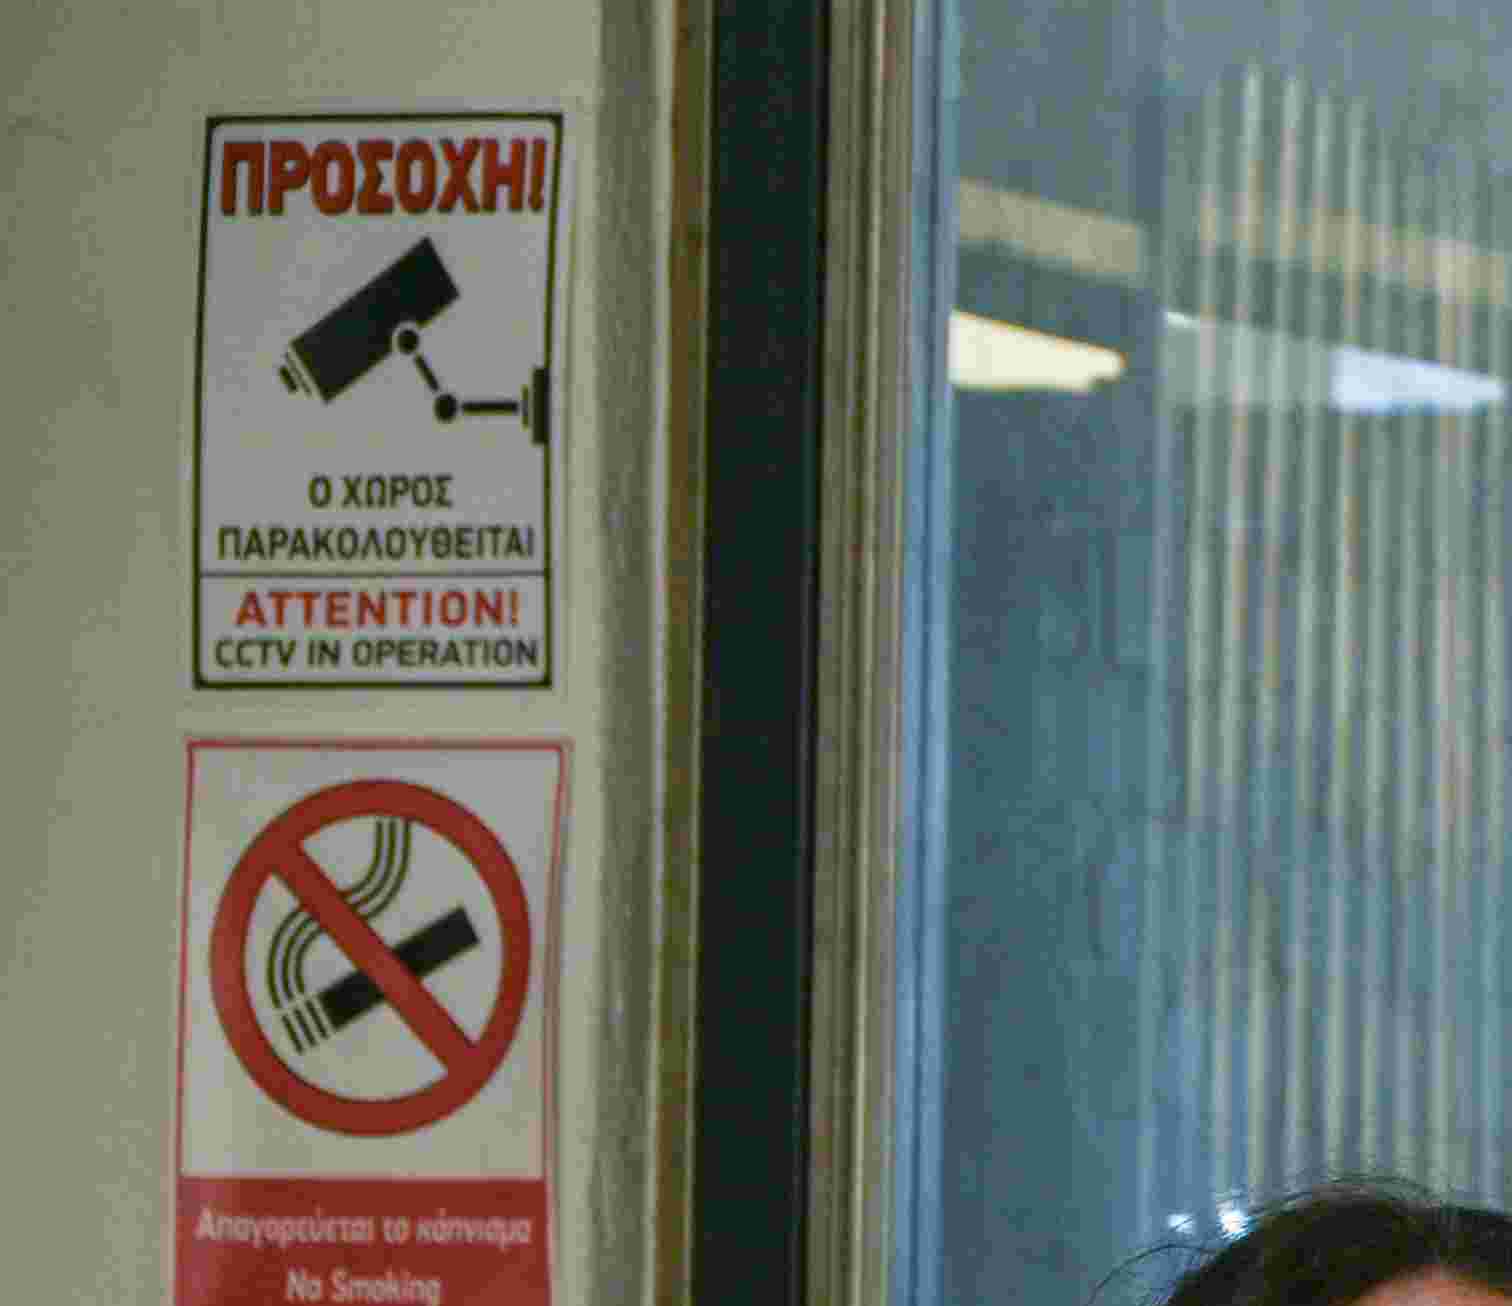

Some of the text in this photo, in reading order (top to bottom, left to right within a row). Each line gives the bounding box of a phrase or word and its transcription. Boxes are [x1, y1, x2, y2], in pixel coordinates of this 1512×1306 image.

[219, 138, 548, 216] ΠΡΟΣΟΧΗ!
[308, 474, 454, 508] Ο ΧΩΡΟΣ
[217, 524, 534, 561] ΠΑΡΑΚΟΛΟΥΘΕΙΤΑΙ
[235, 590, 520, 629] ATTENTION!
[214, 636, 539, 668] CCTV IN OPERATION
[195, 1207, 532, 1252] Απαγορεύεται το κάπνισμα
[286, 1266, 322, 1303] No
